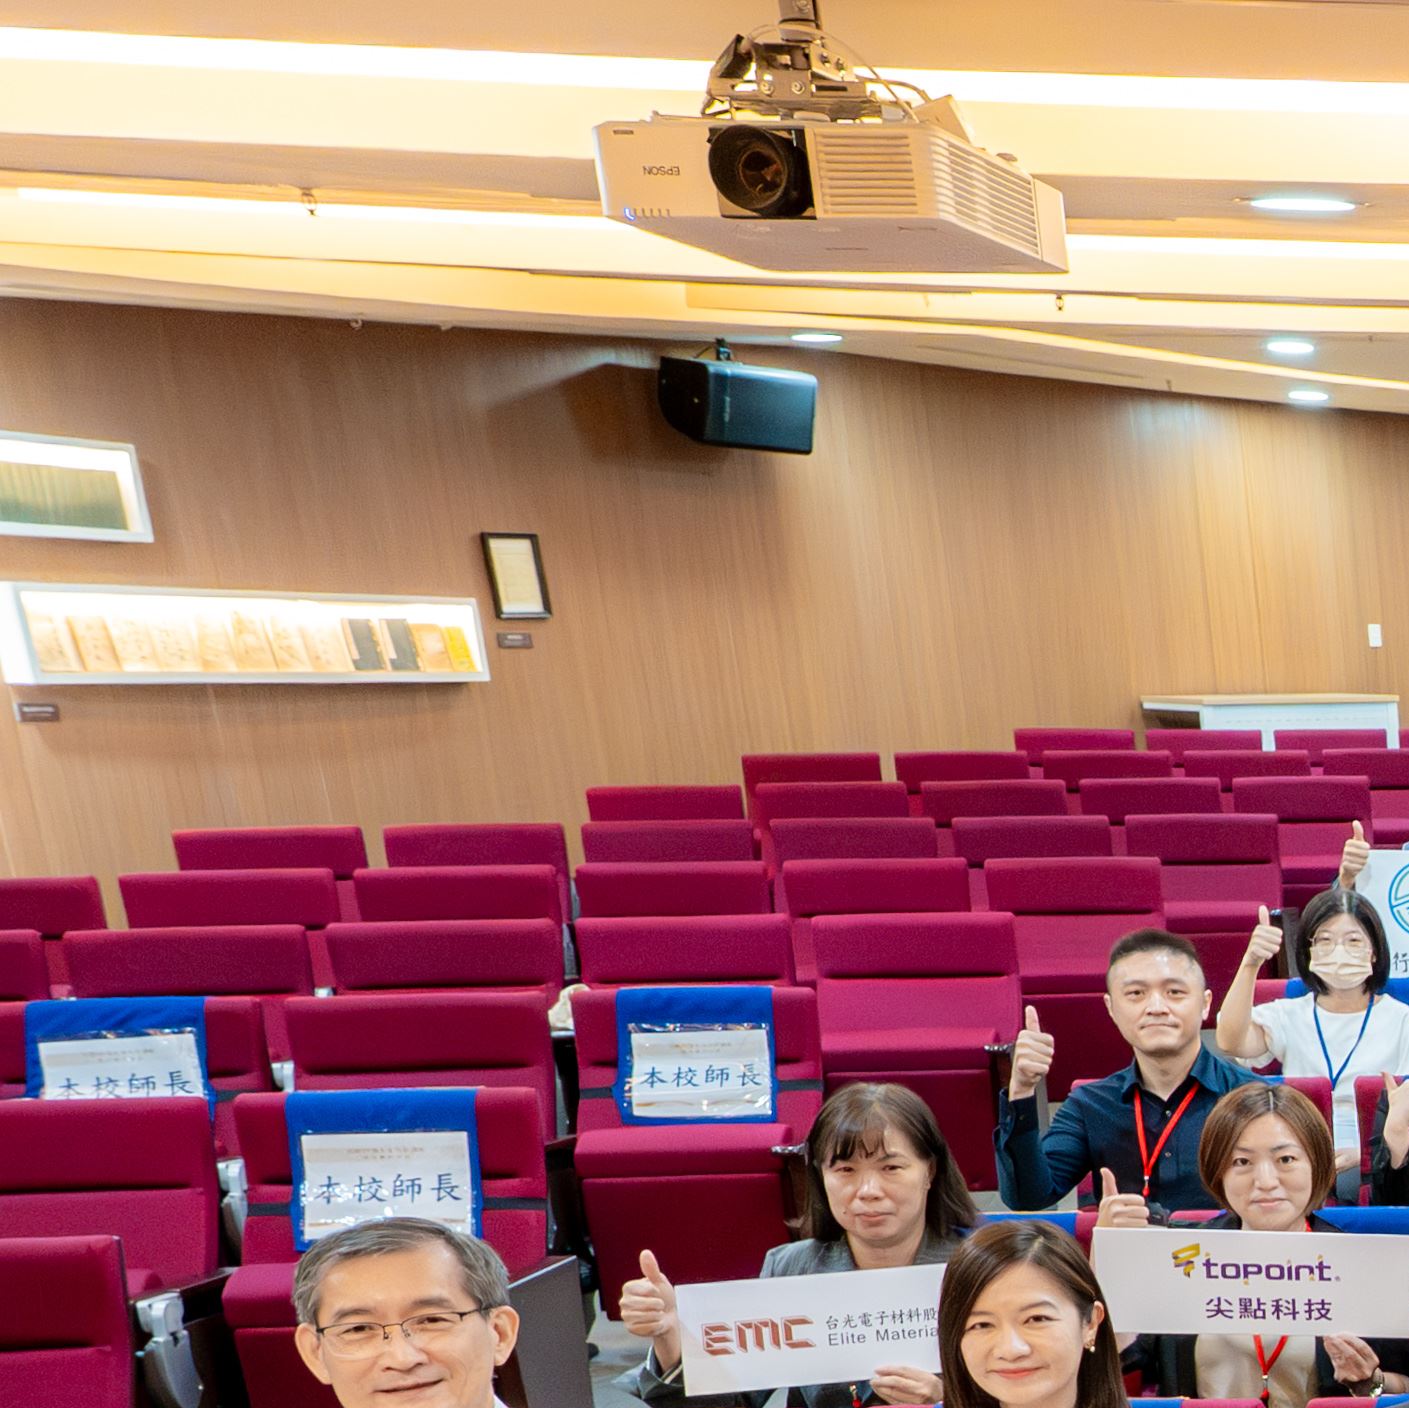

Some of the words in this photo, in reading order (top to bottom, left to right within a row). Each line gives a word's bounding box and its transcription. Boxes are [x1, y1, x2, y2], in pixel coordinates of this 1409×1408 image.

[643, 165, 680, 176] EPSON
[56, 1070, 195, 1099] 本校師長
[640, 1063, 762, 1088] 本校師長
[314, 1172, 462, 1205] 本校師長
[1201, 1251, 1332, 1286] topoint
[1205, 1297, 1333, 1321] 尖點科技
[702, 1314, 817, 1357] EMC
[828, 1332, 867, 1347] Elite
